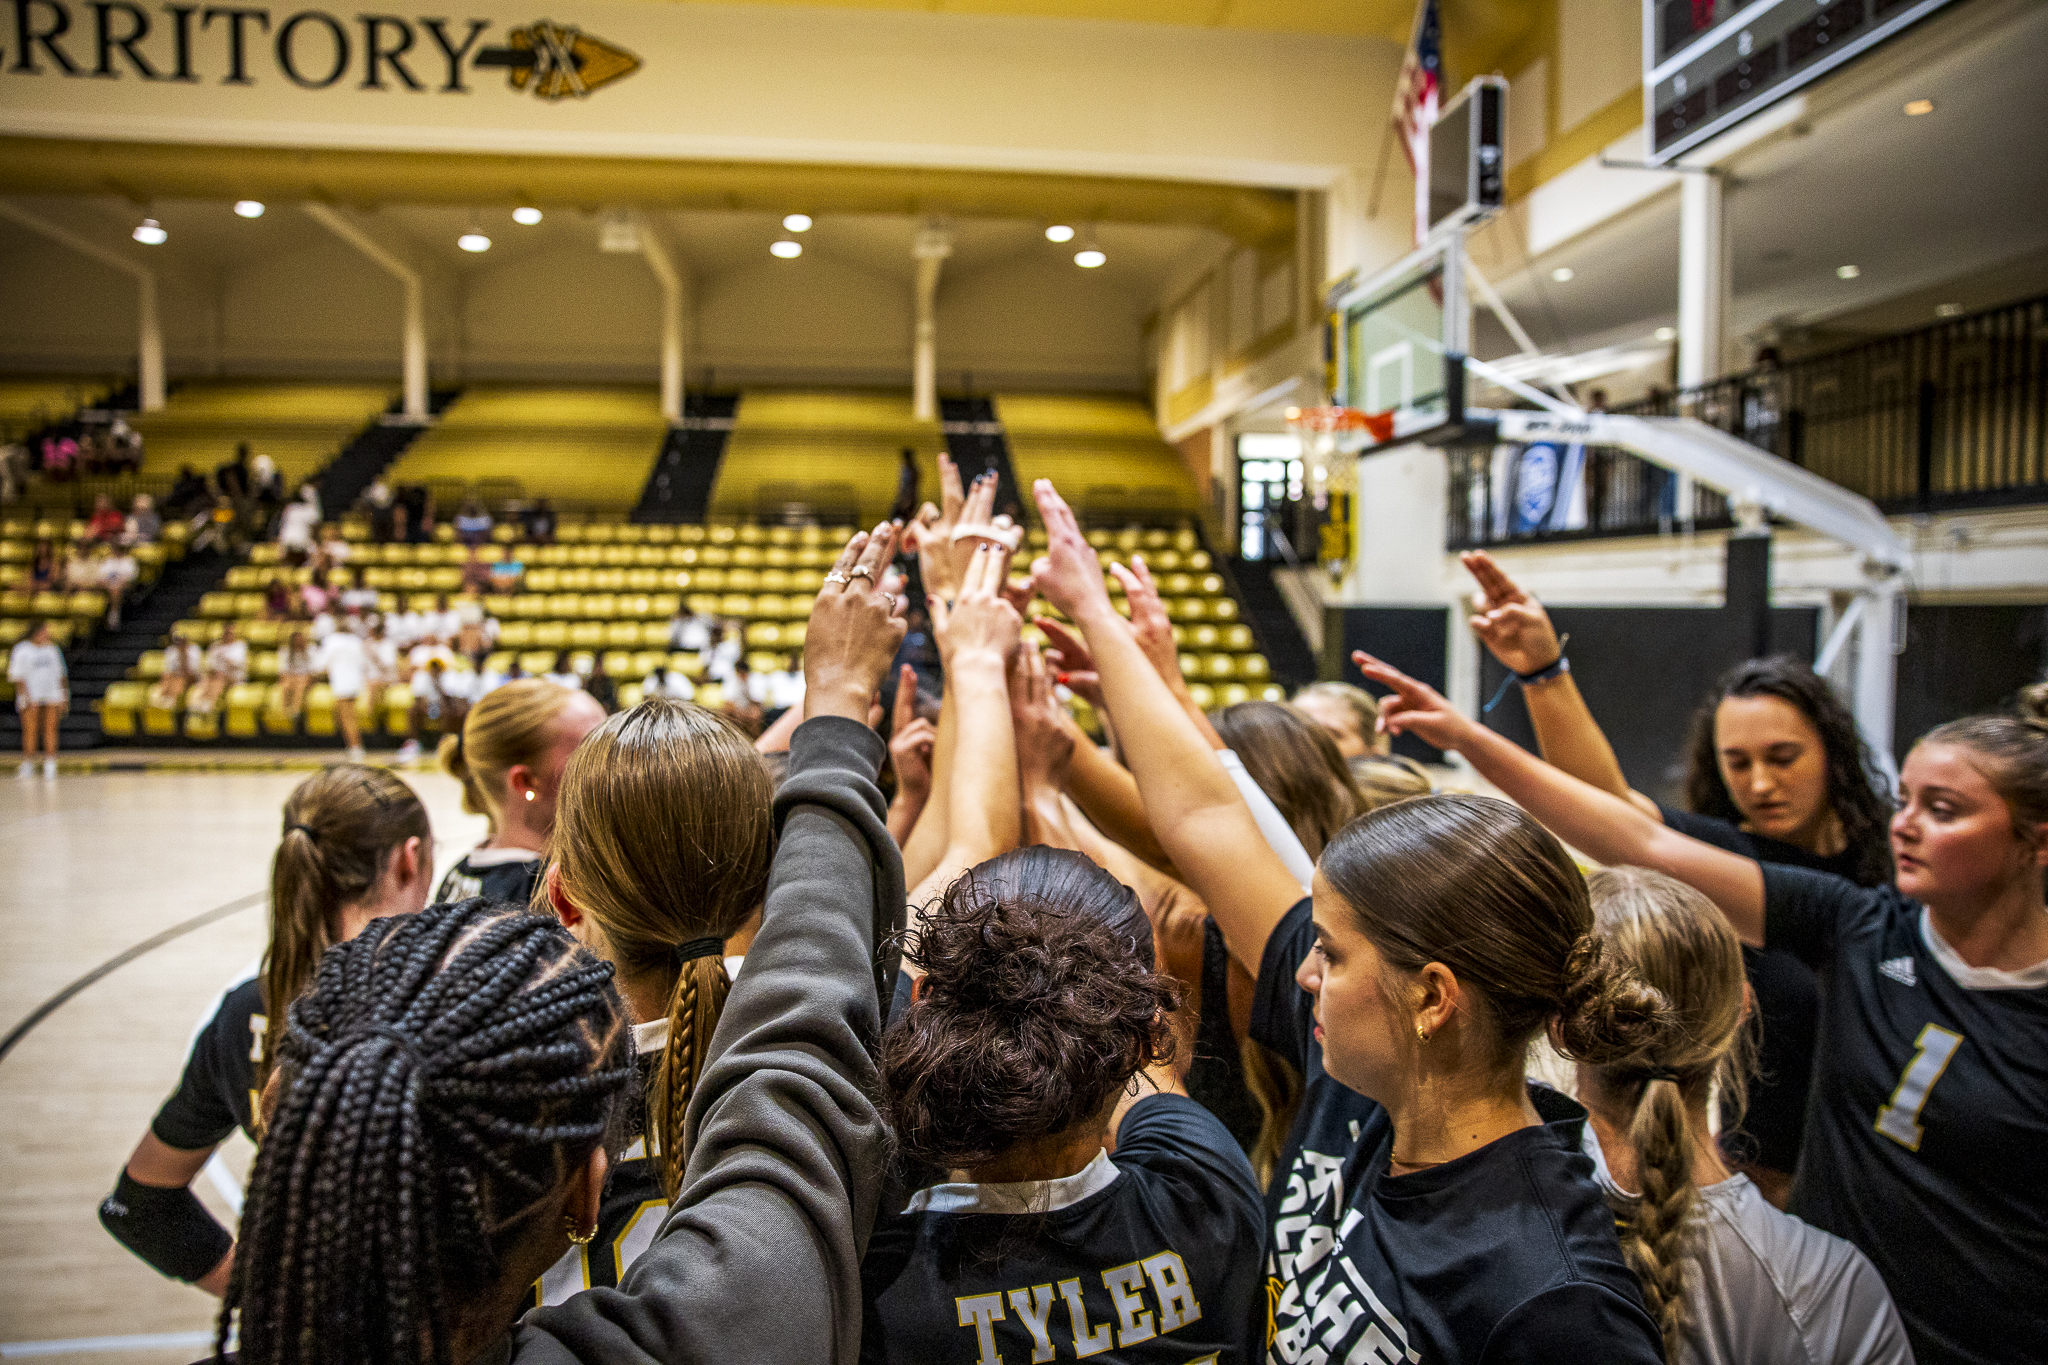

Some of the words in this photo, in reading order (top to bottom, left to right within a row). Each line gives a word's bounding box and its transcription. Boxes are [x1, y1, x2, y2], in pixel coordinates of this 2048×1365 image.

[0, 0, 490, 94] RRITORY
[1874, 1022, 1964, 1152] 1
[955, 1250, 1202, 1365] TYLER
